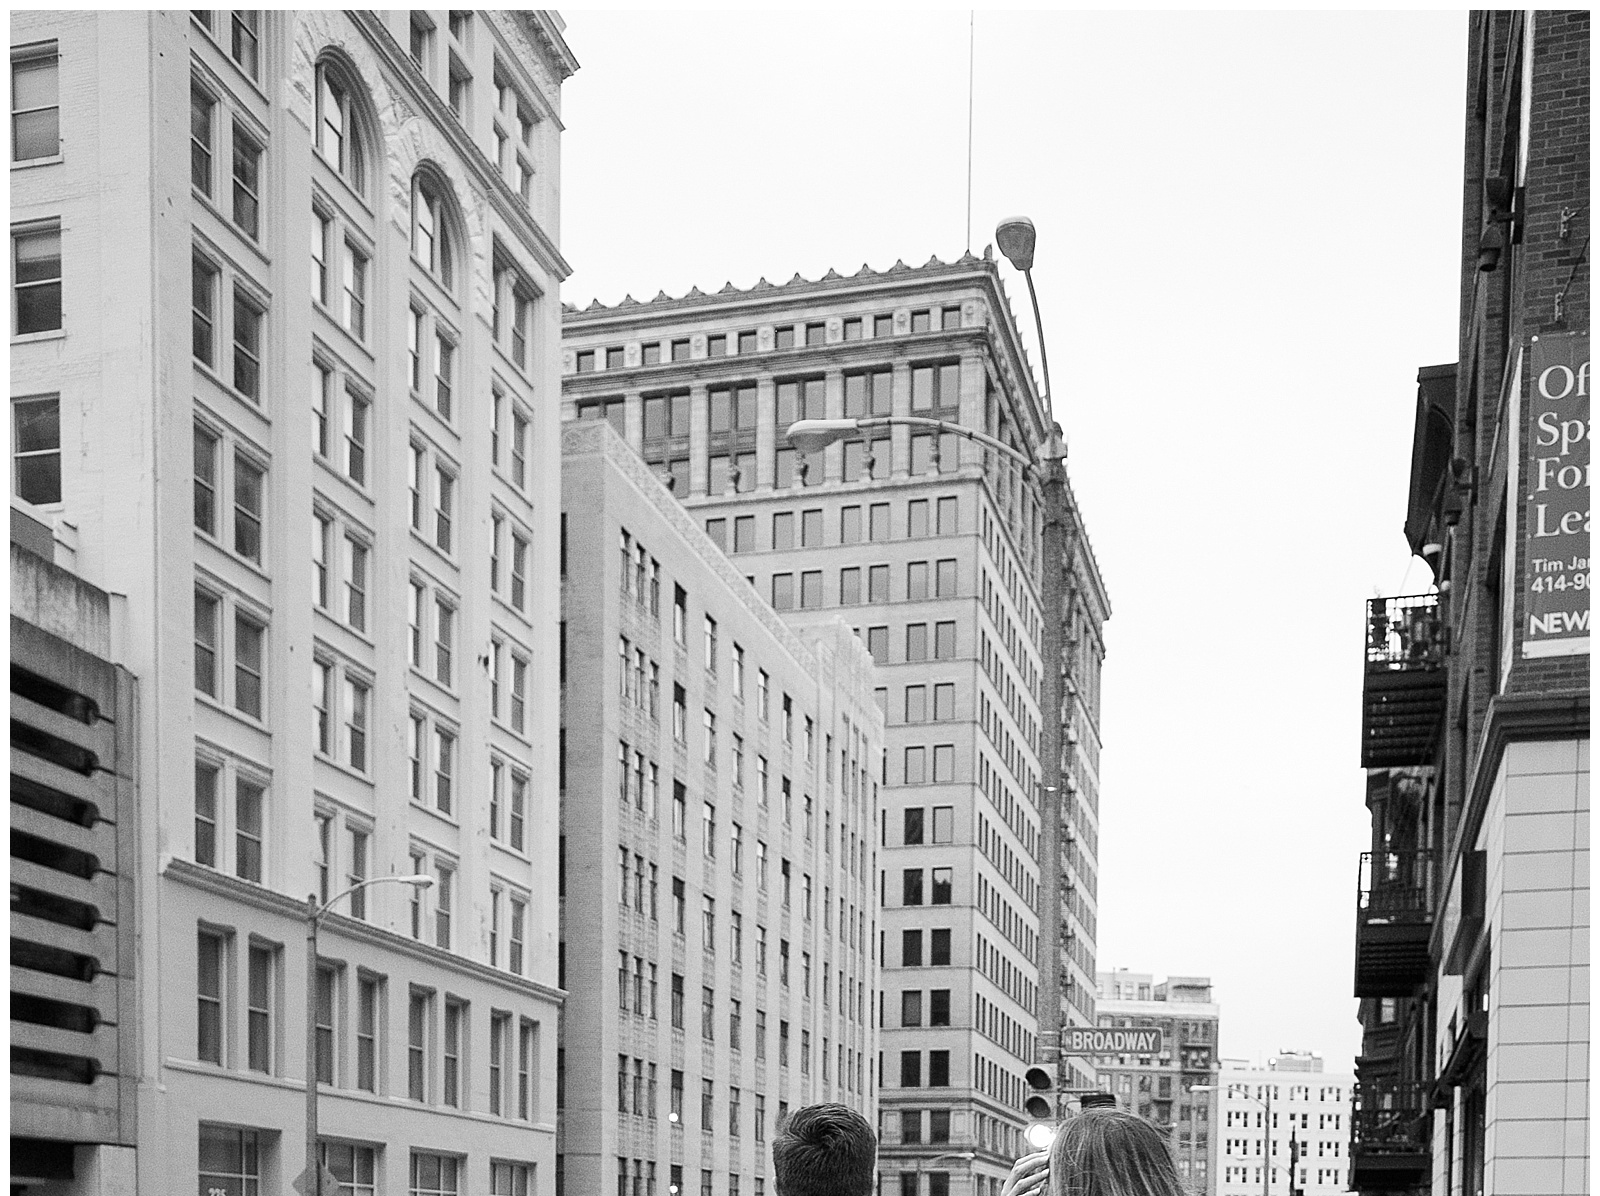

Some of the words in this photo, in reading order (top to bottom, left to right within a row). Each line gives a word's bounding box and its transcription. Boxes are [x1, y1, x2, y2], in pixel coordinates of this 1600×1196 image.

[1536, 411, 1590, 456] Sp
[1531, 558, 1563, 573] Tim
[1072, 1031, 1156, 1050] BROADWAY
